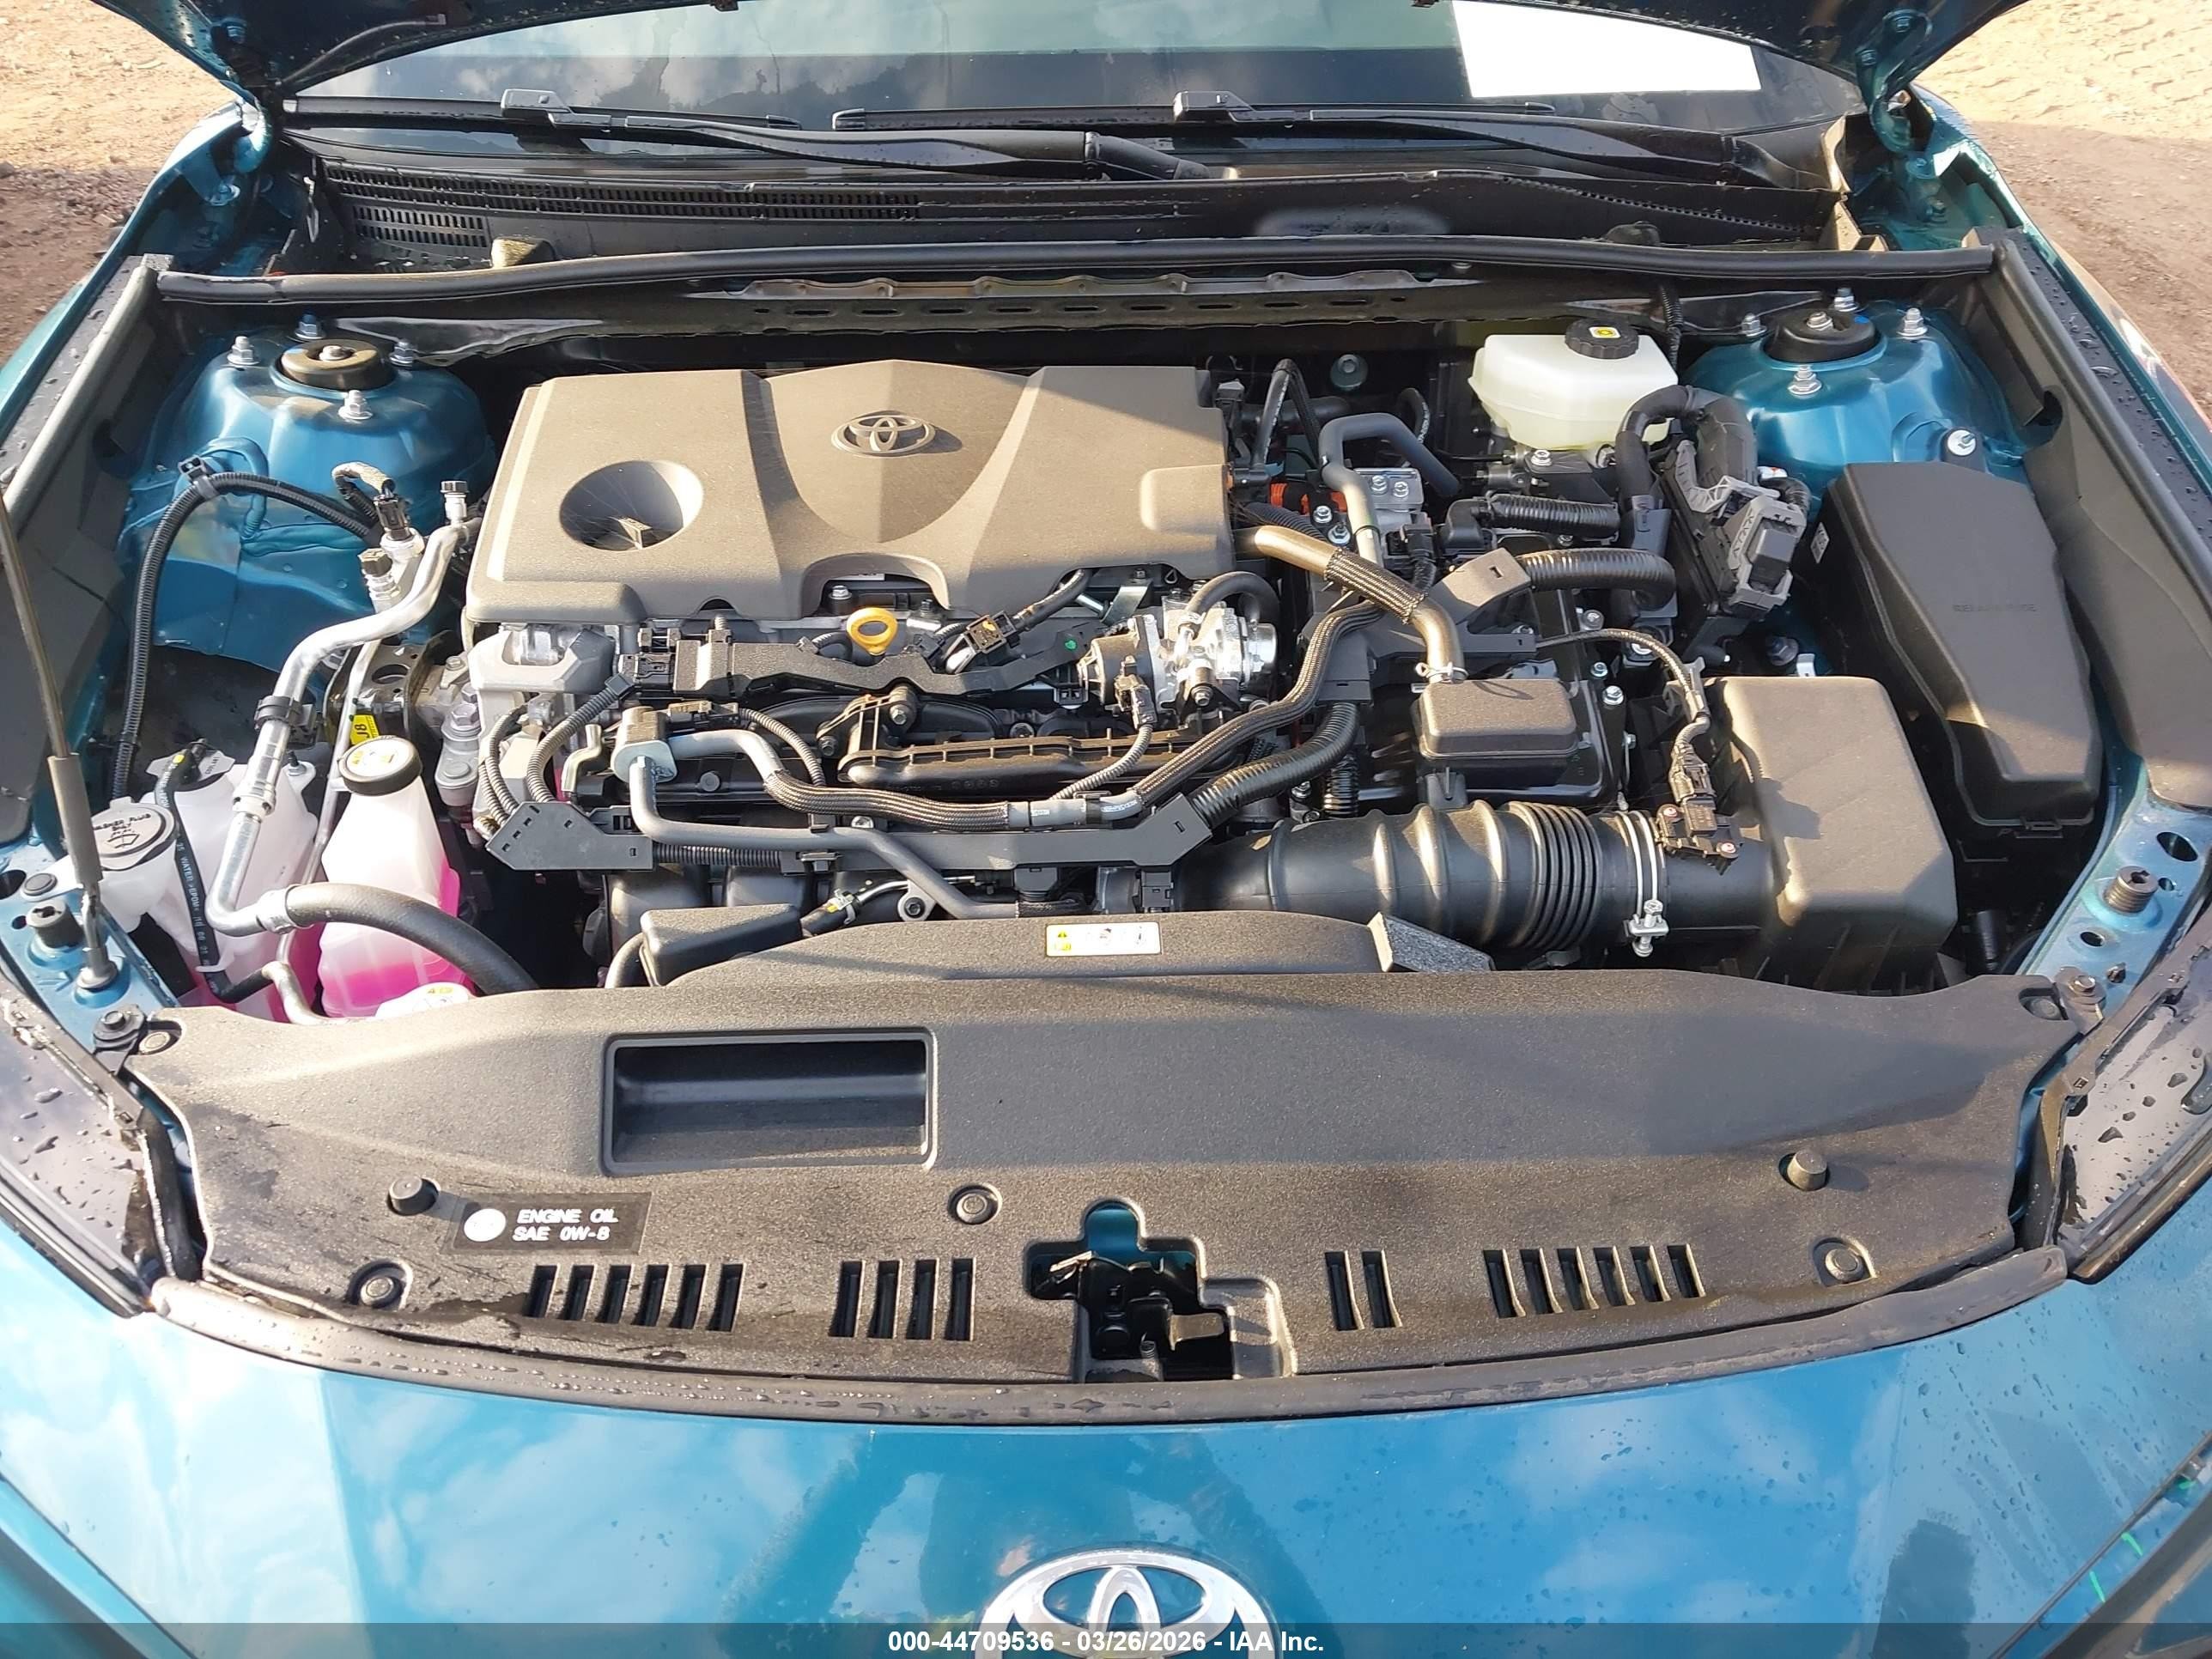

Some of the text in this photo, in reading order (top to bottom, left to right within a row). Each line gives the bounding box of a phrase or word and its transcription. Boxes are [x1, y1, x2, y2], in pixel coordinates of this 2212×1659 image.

[180, 856, 194, 881] WATER
[517, 1208, 619, 1224] ENGINE OIL
[512, 1226, 611, 1242] SAE 0W-8
